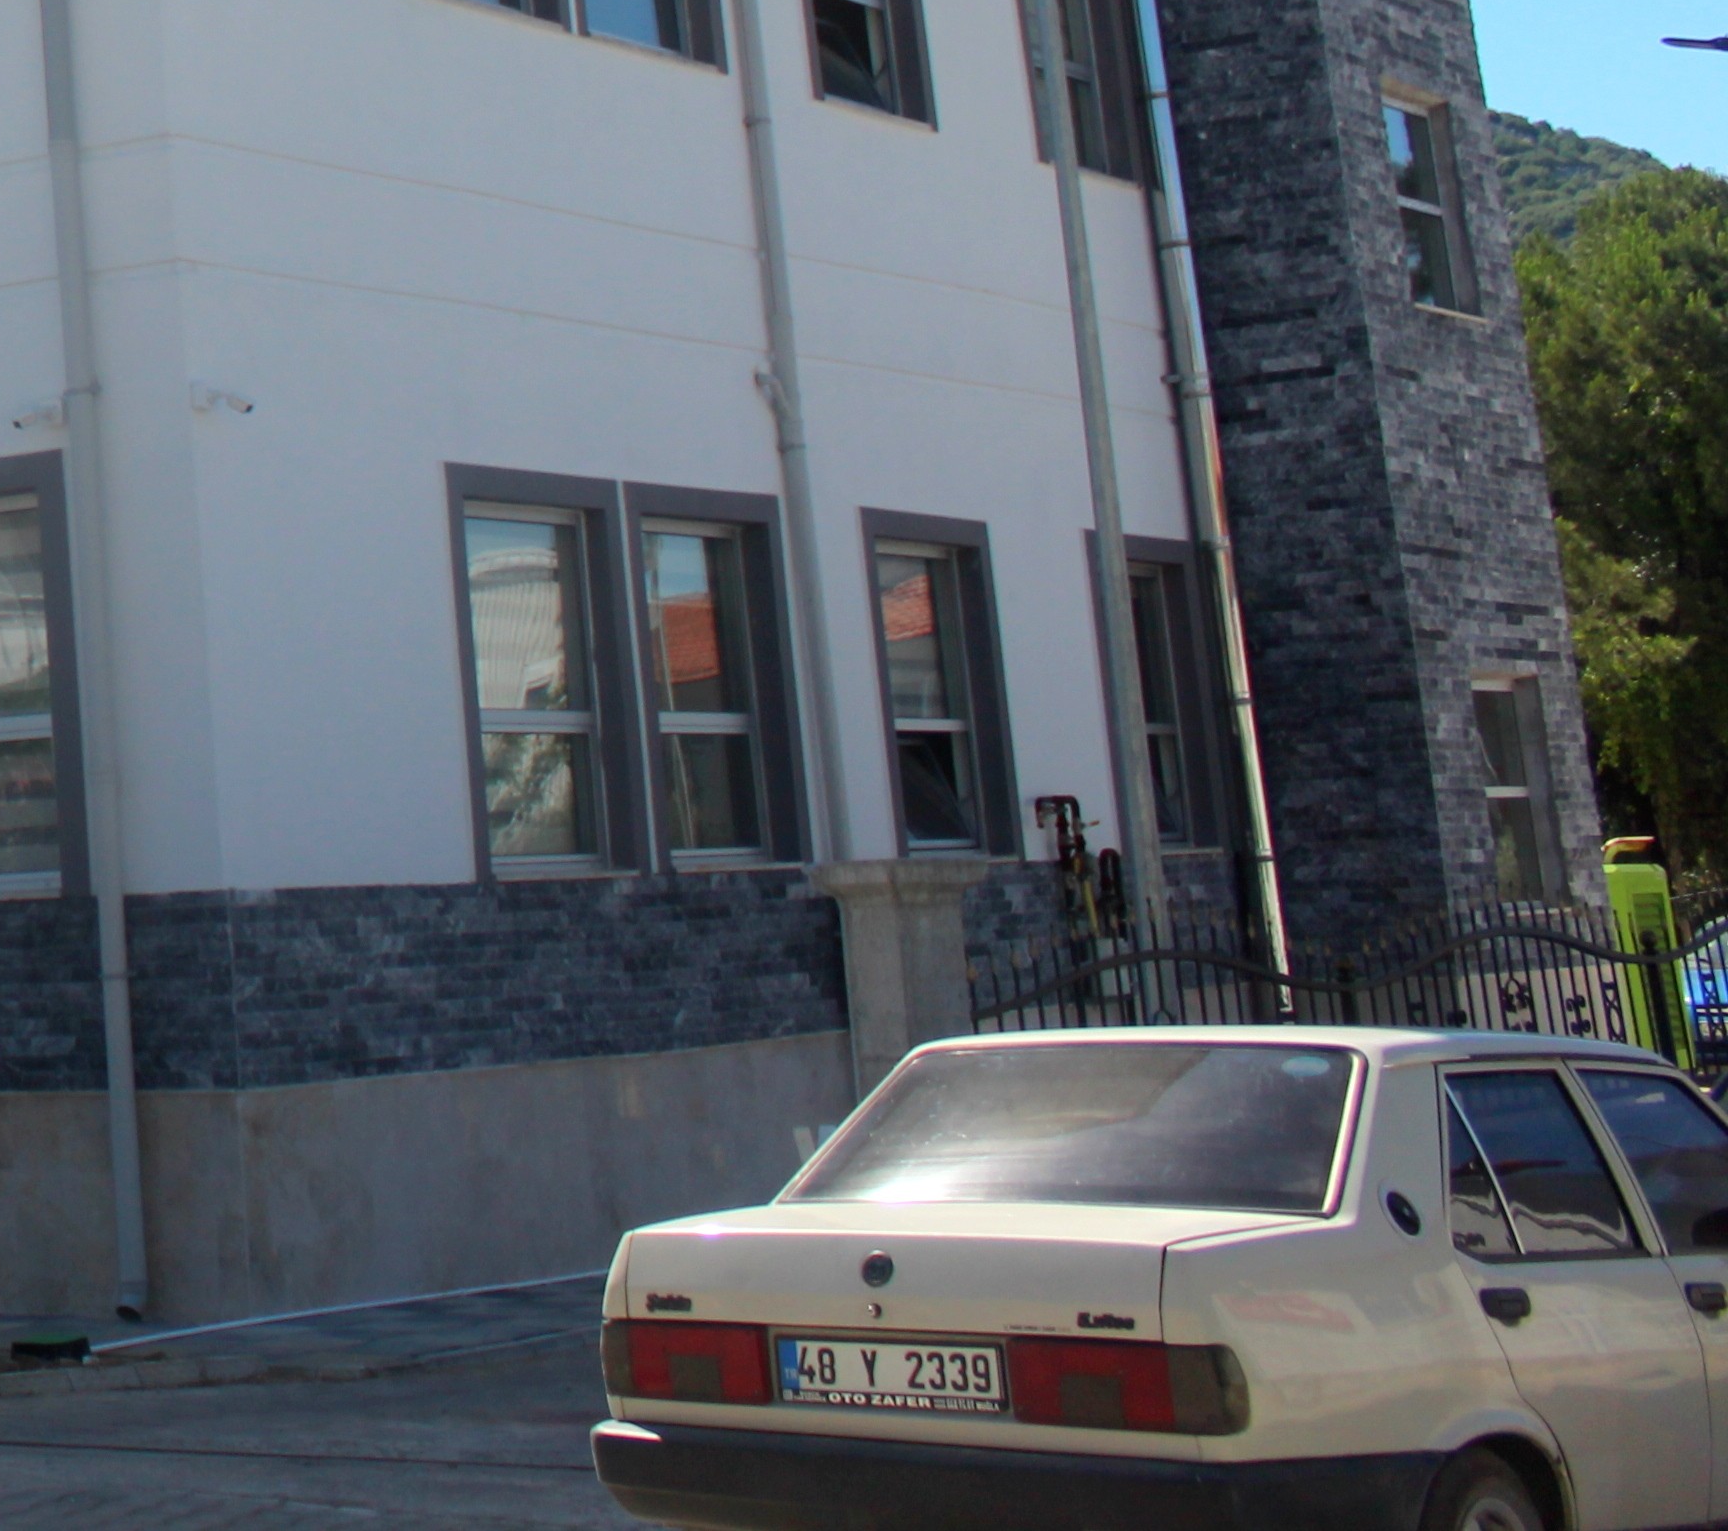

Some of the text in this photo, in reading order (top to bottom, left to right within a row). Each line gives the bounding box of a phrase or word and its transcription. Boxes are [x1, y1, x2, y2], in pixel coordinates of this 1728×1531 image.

[798, 1346, 992, 1393] 48 Y 2339
[828, 1391, 866, 1405] OTO
[870, 1394, 932, 1409] ZAFER
